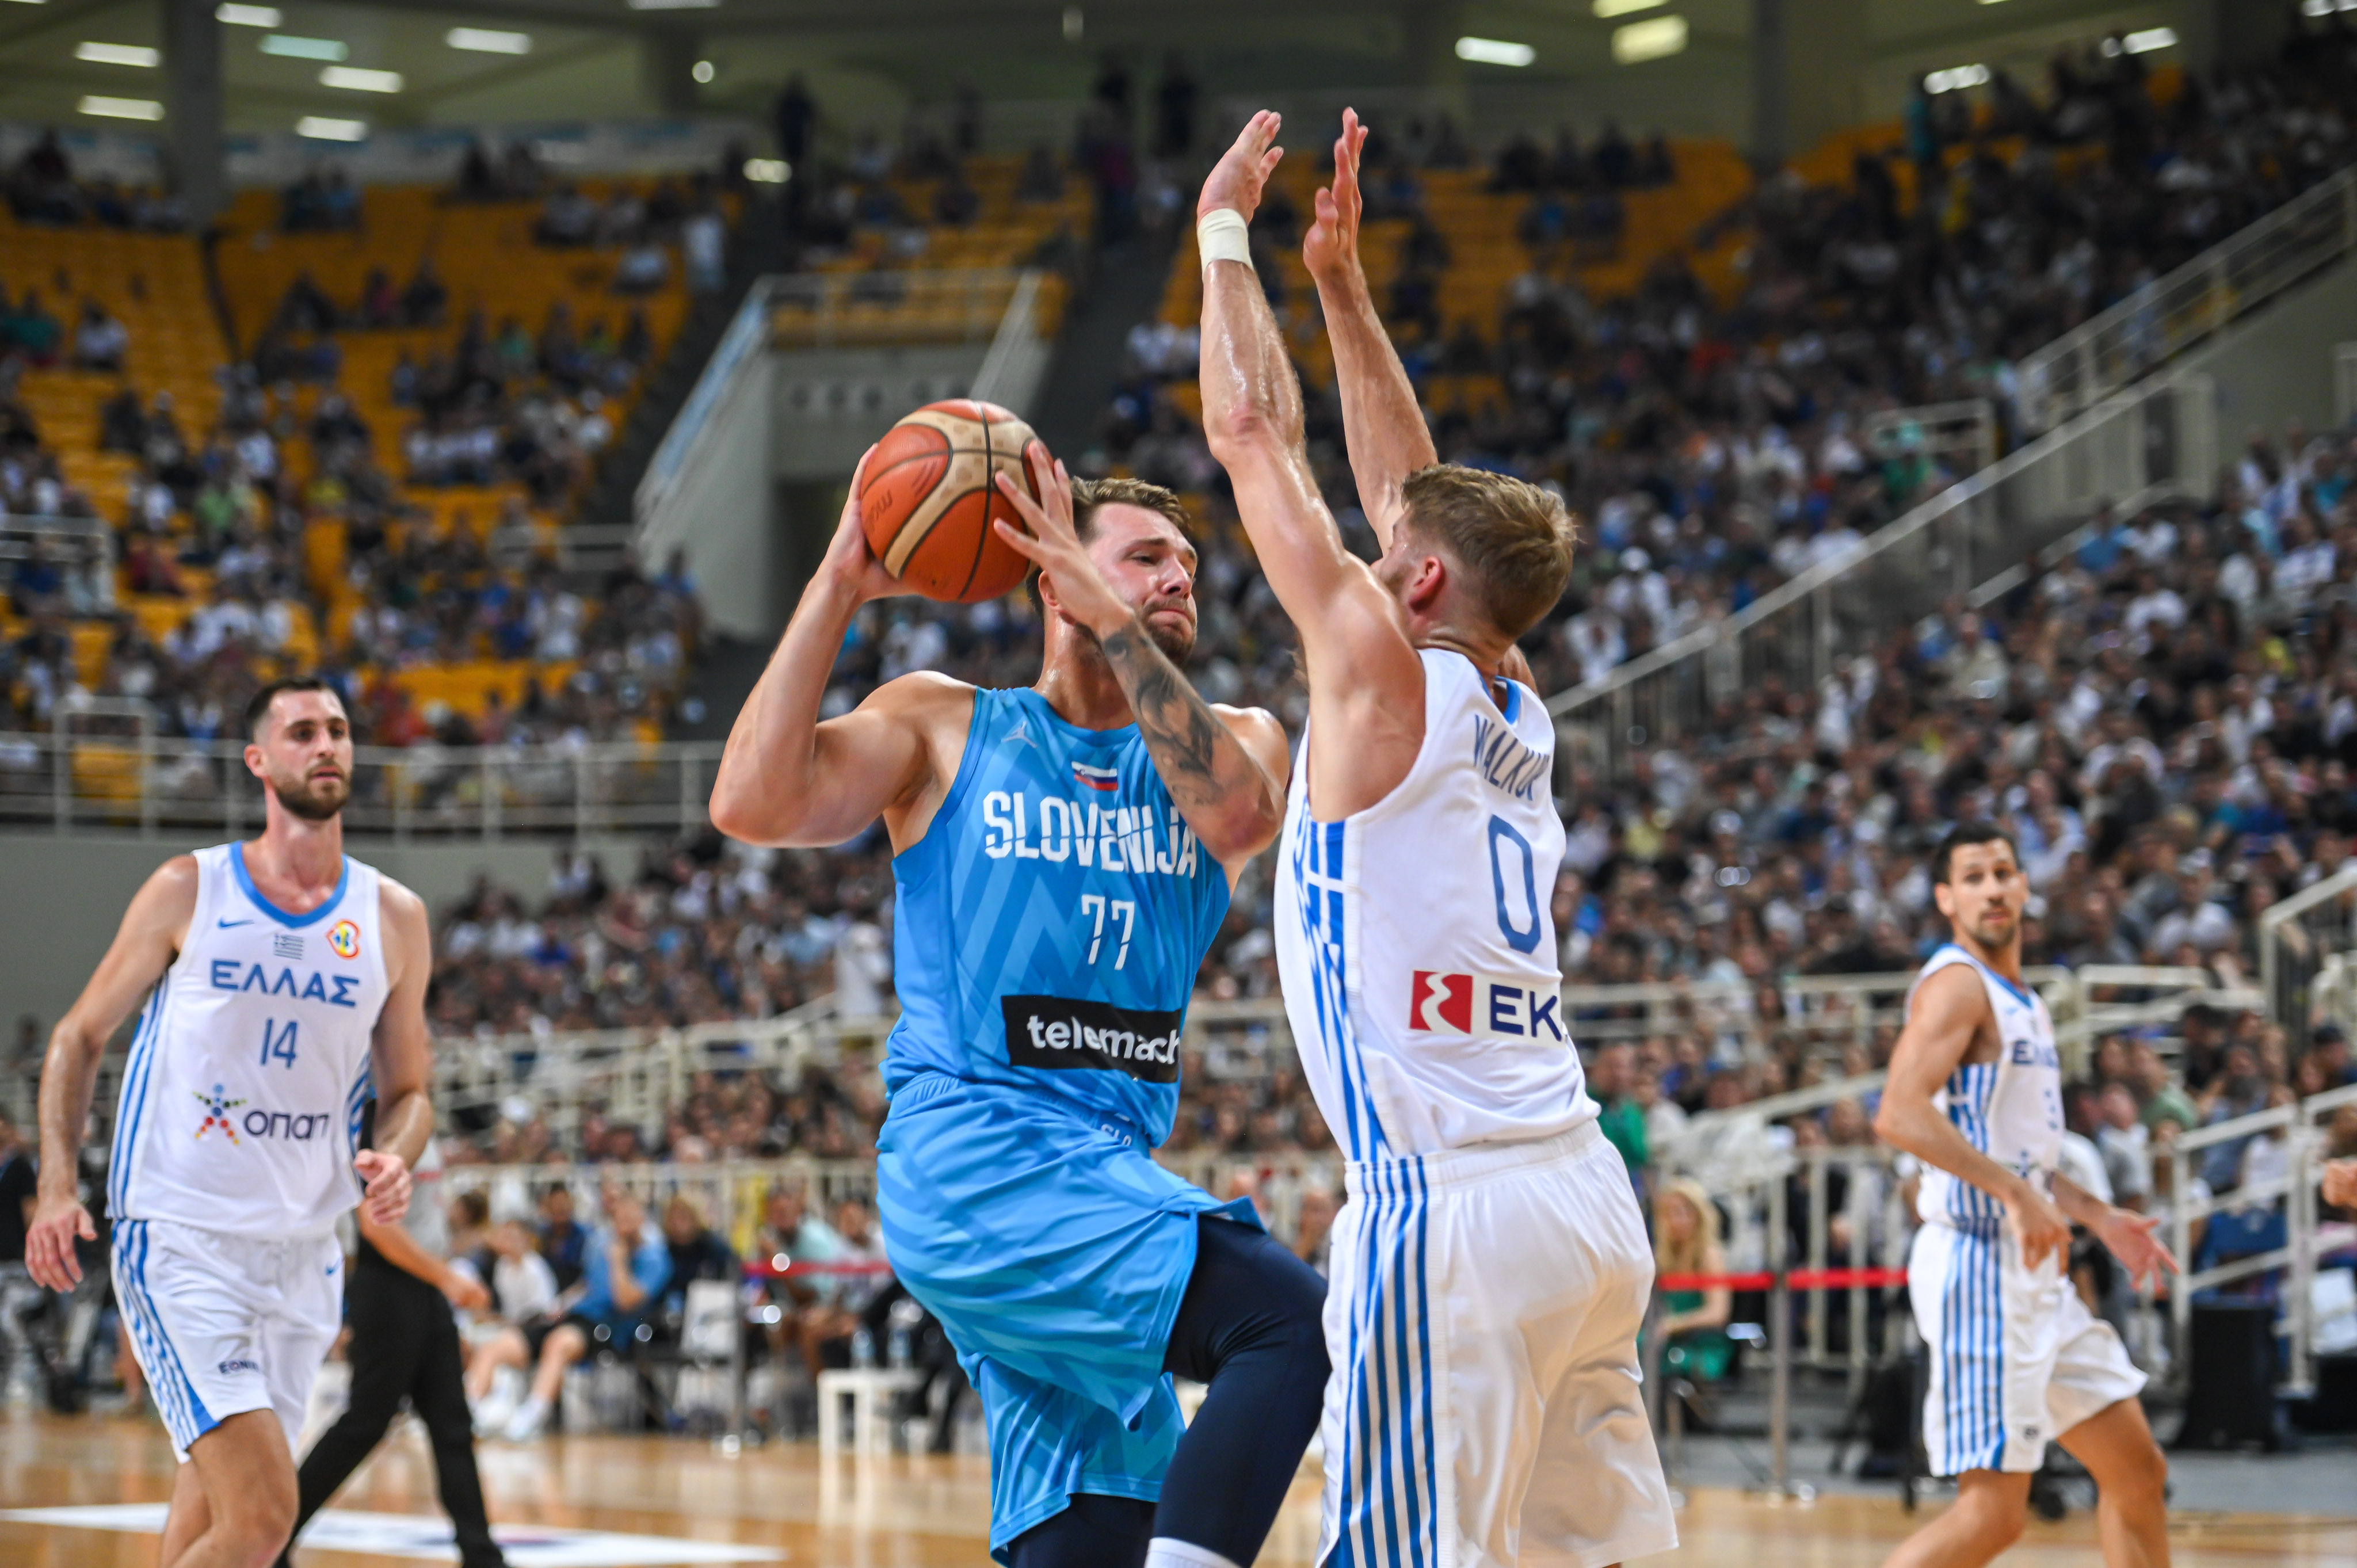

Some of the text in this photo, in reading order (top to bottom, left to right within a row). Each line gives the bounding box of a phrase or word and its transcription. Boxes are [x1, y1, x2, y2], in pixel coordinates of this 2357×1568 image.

[983, 791, 1197, 879] SLOVENIJA
[1488, 814, 1542, 955] 0
[1081, 894, 1135, 971] 77
[210, 959, 360, 1008] ΕΛΛΑΣ
[1490, 983, 1567, 1043] EK
[260, 1017, 299, 1069] 14
